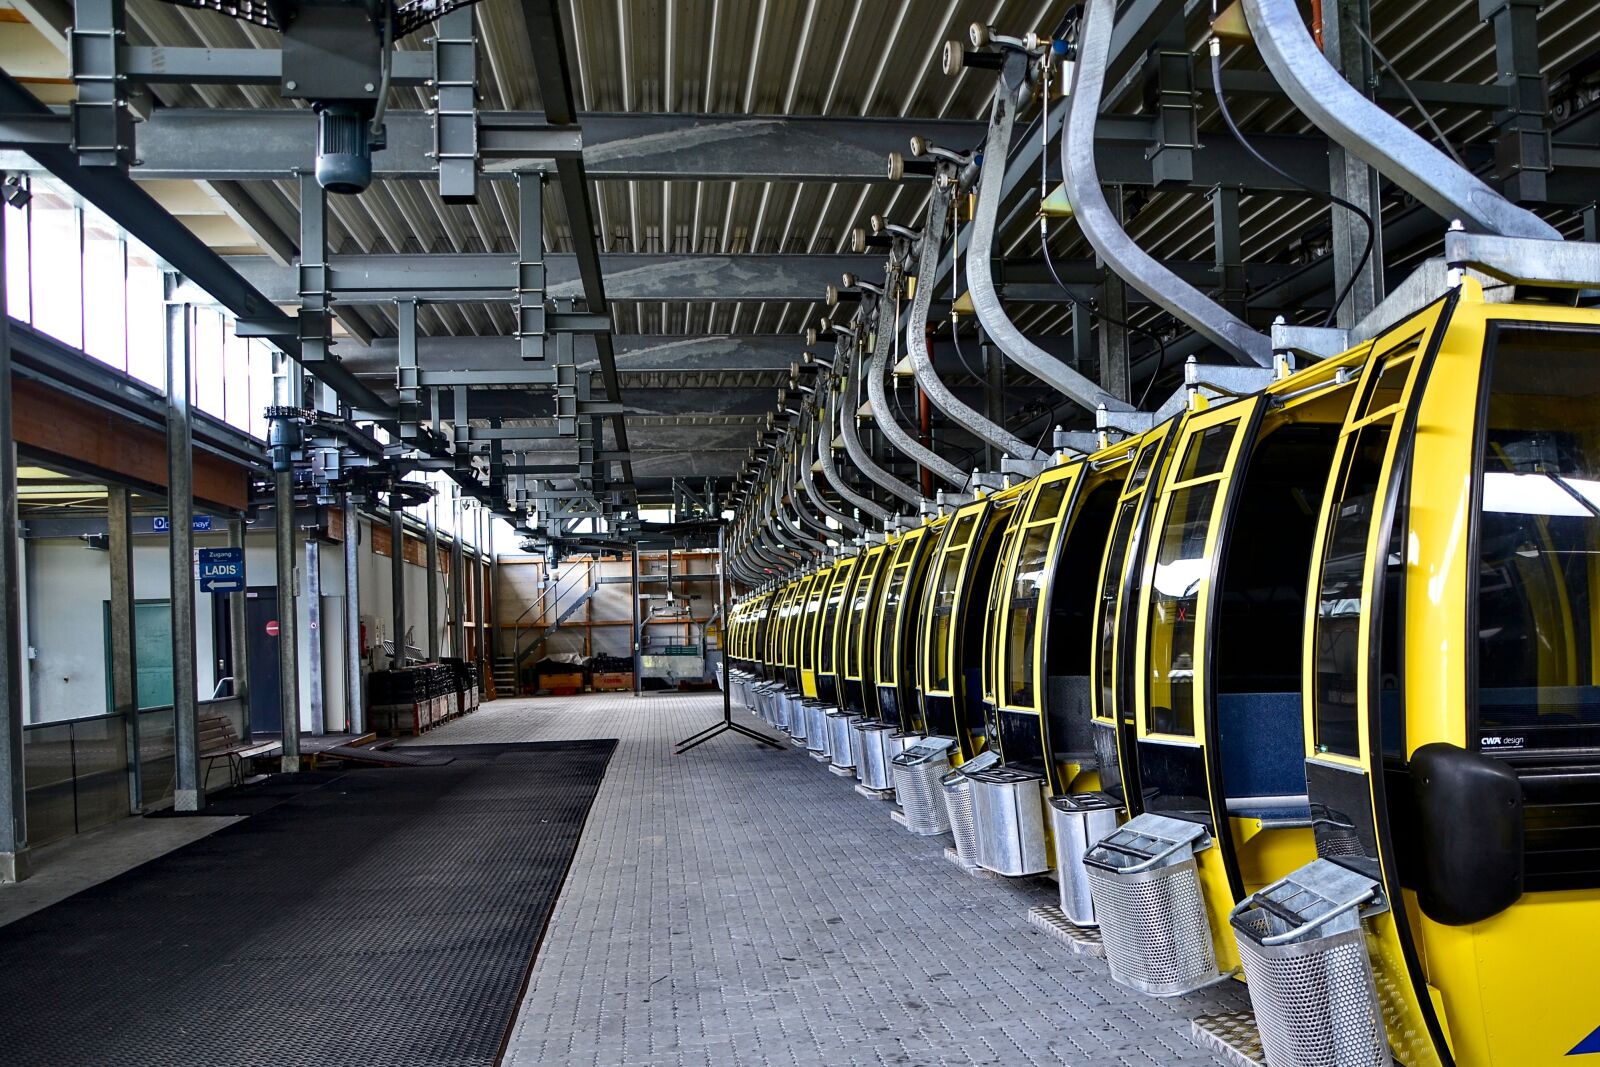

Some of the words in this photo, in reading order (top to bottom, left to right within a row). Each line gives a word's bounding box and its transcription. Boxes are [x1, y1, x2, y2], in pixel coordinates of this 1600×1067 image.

[205, 565, 236, 575] LADIS
[1481, 737, 1502, 745] CWA
[1503, 736, 1524, 745] design
